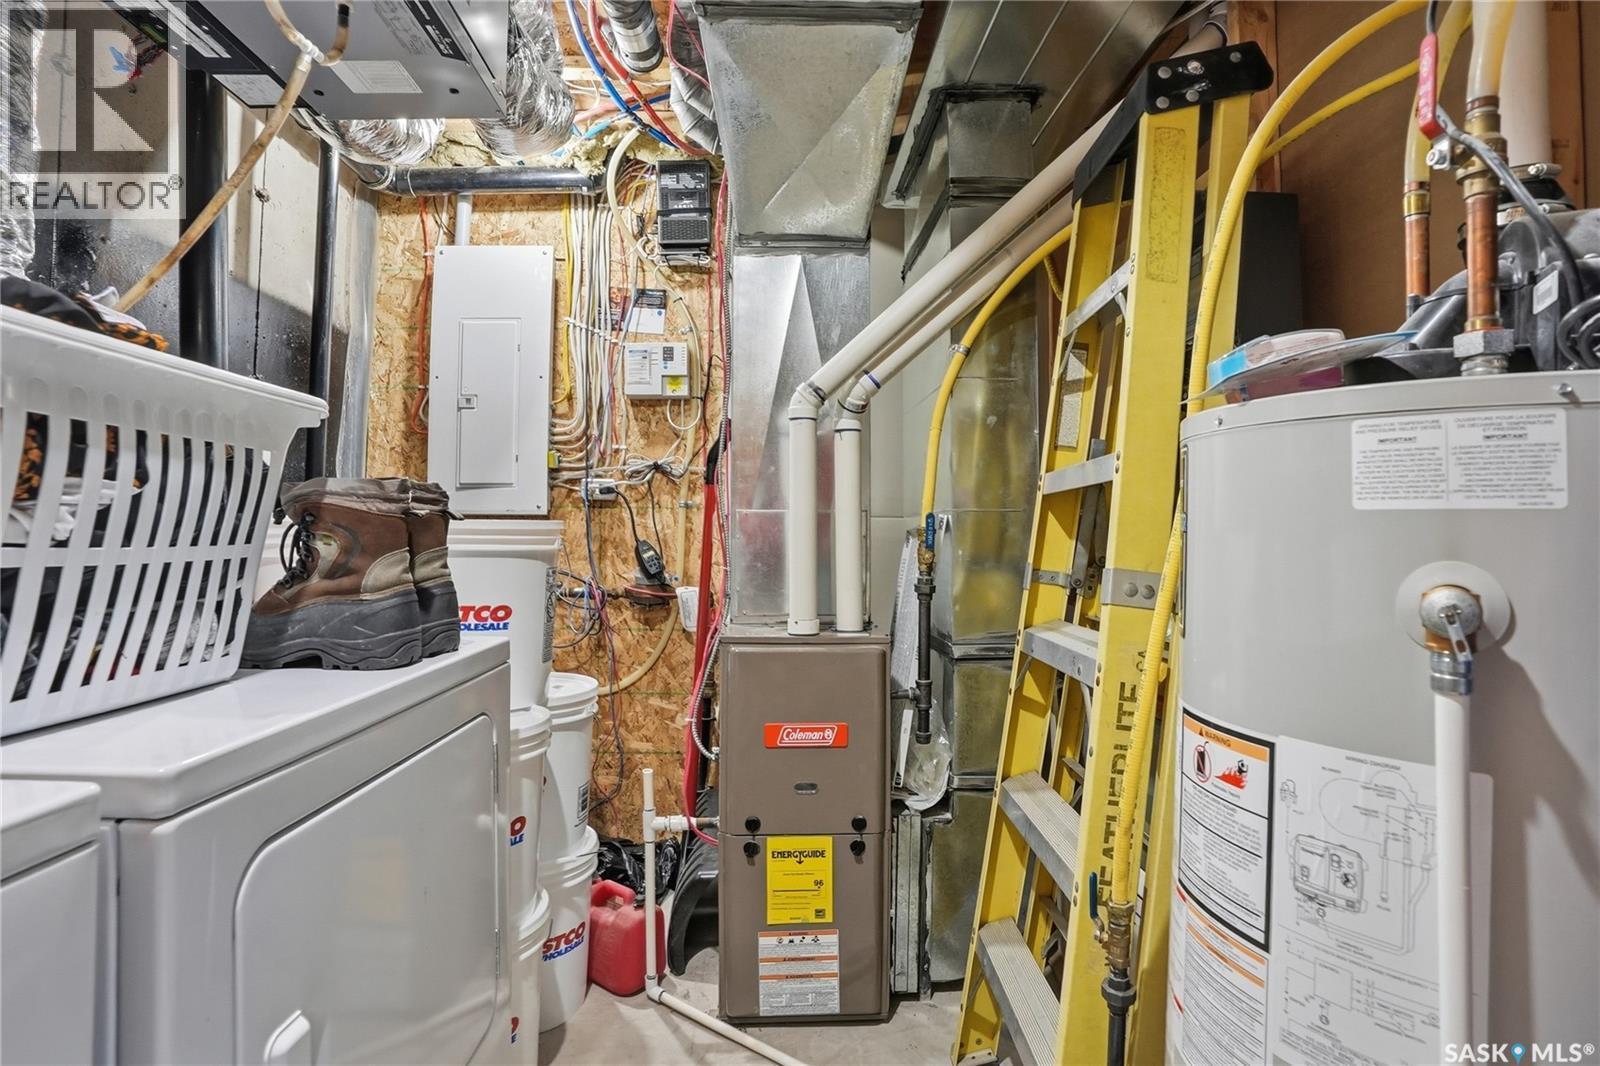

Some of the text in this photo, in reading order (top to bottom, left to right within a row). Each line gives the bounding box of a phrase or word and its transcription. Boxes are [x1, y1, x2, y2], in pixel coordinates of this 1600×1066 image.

[459, 605, 512, 622] TCO
[459, 622, 510, 632] OLESALE
[783, 728, 823, 741] Coleman
[771, 850, 826, 861] ENERGYGUIDE
[813, 879, 824, 887] 96
[542, 921, 586, 955] STCO
